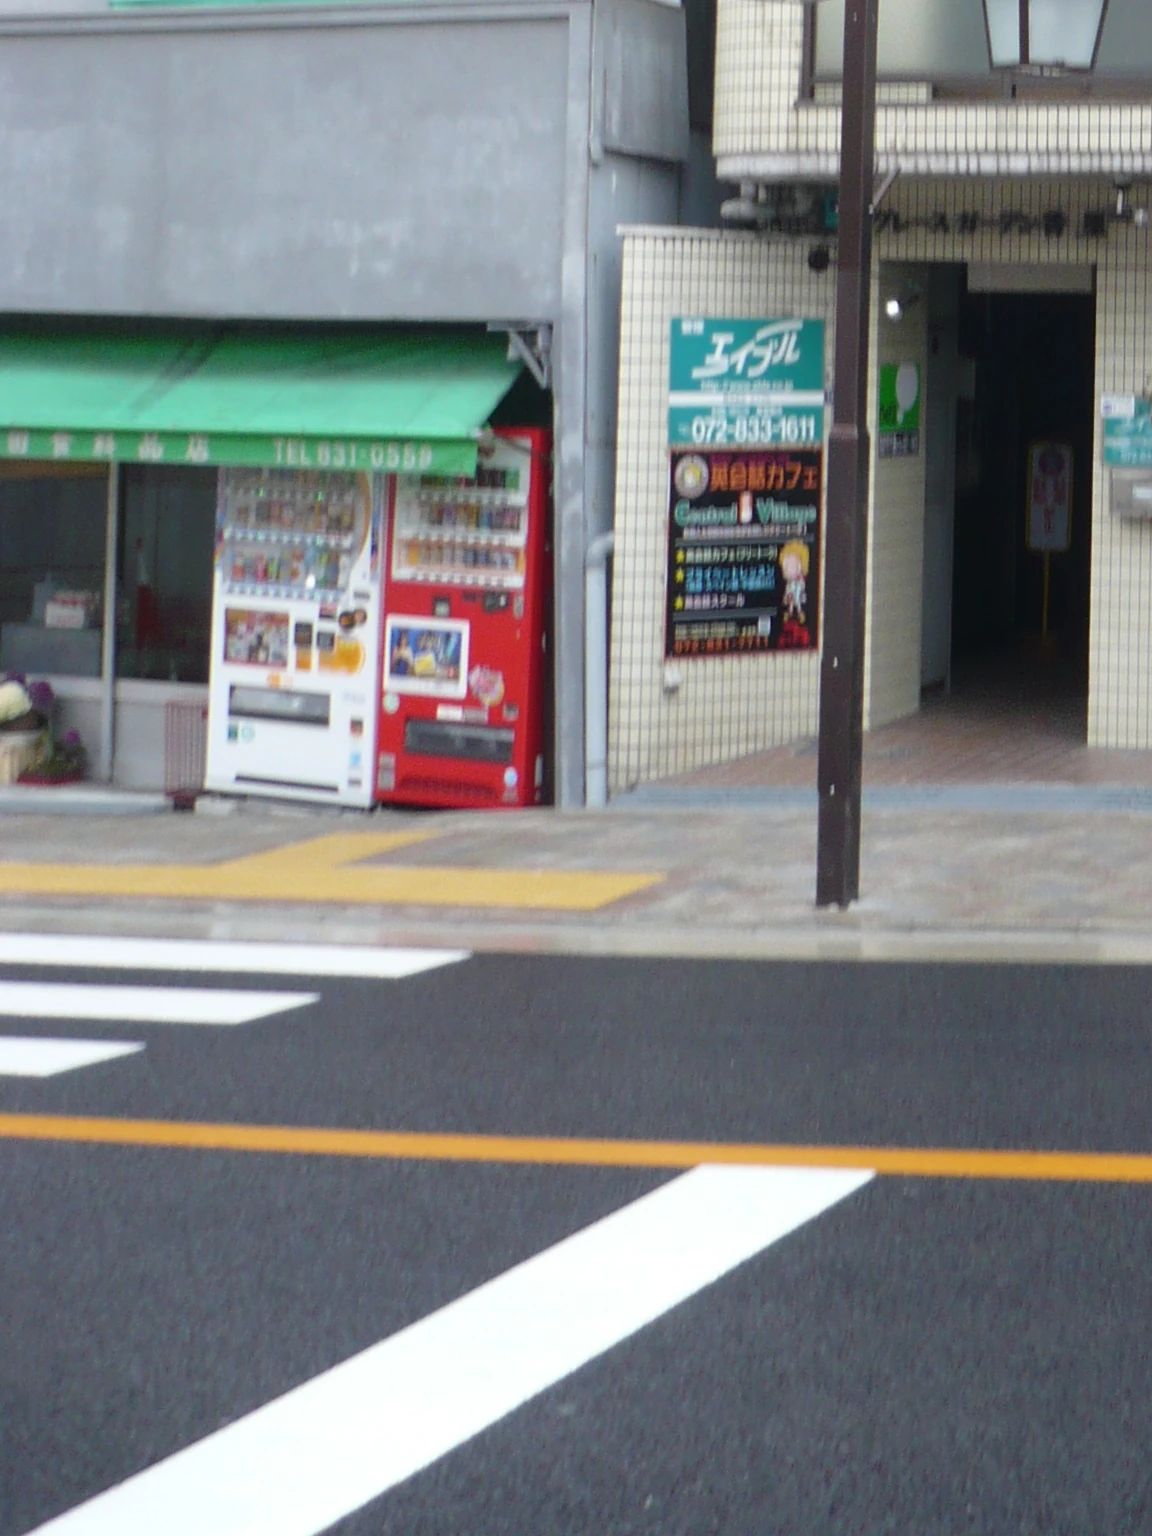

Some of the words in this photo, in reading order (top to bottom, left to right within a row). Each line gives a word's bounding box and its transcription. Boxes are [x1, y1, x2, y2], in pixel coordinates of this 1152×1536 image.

[691, 319, 804, 379] エイブル
[272, 439, 311, 466] TEL
[710, 460, 818, 491] 英会話カフェ
